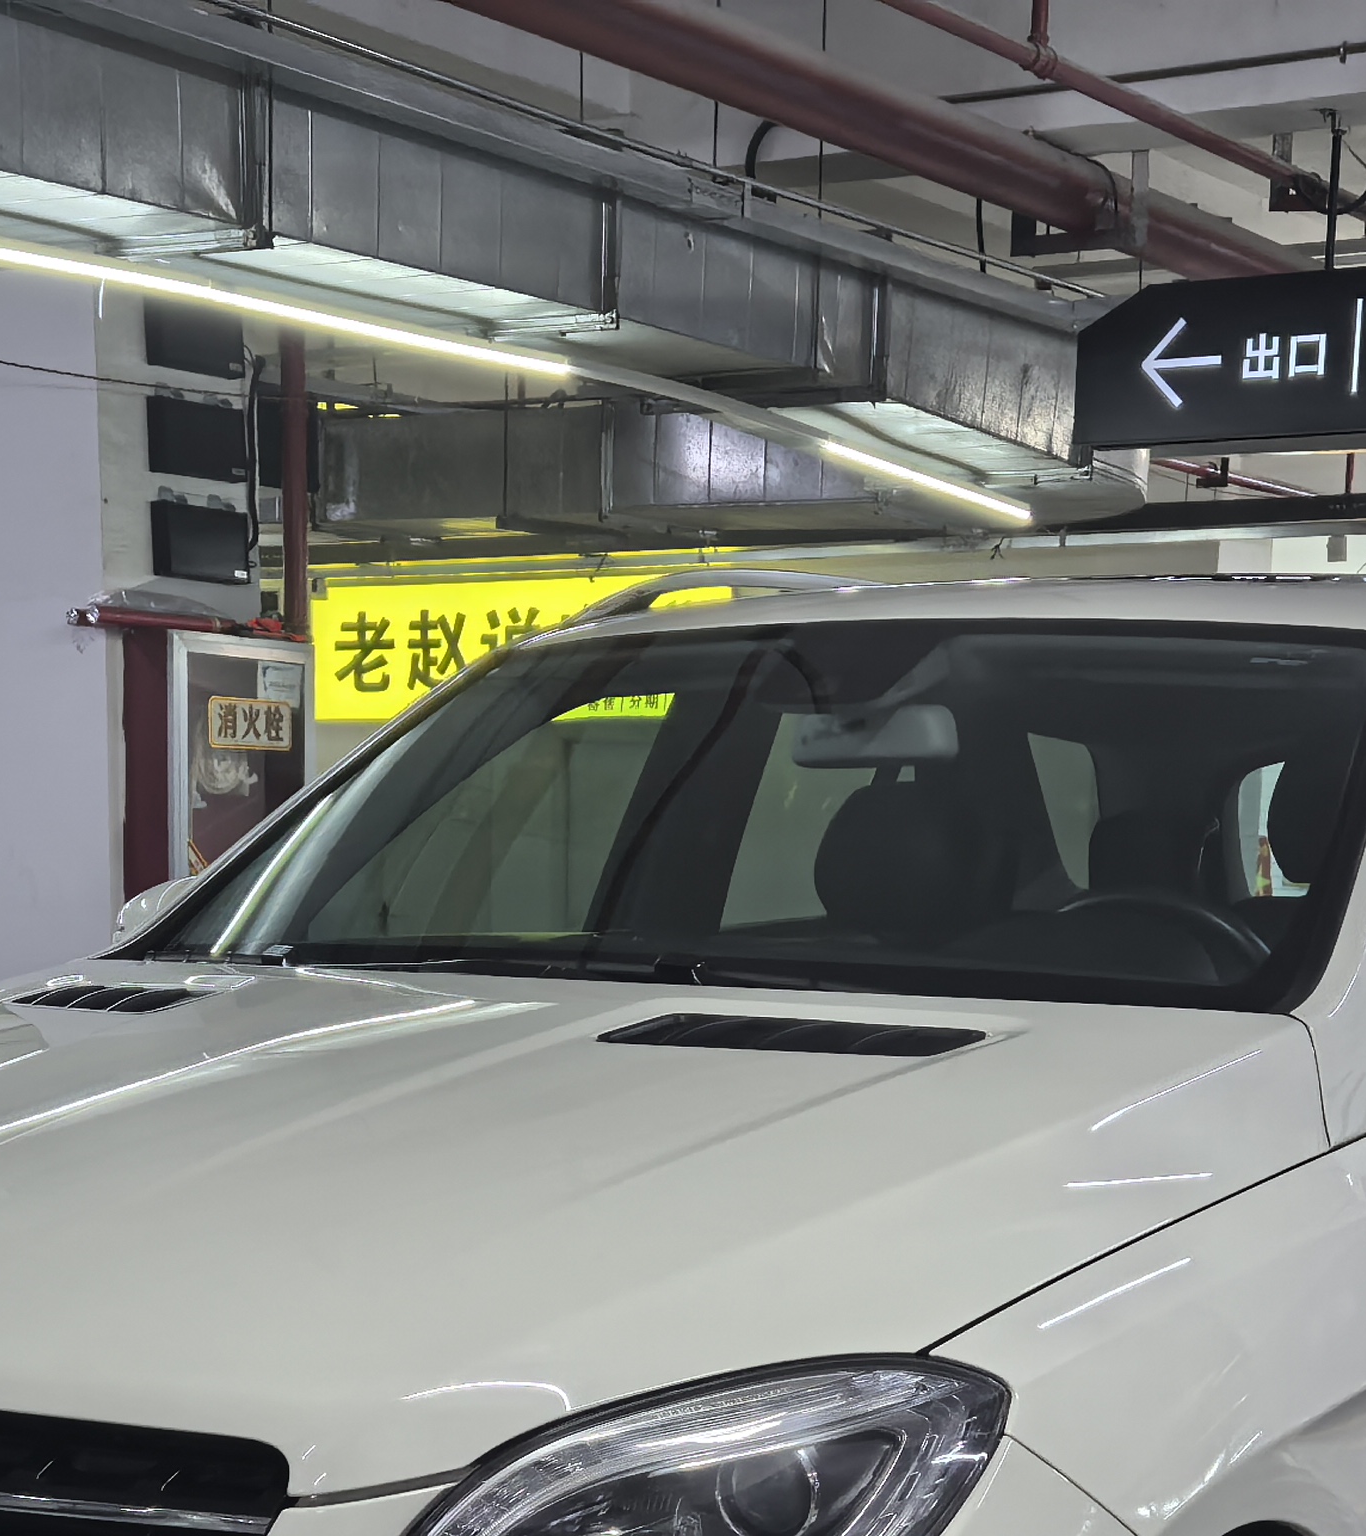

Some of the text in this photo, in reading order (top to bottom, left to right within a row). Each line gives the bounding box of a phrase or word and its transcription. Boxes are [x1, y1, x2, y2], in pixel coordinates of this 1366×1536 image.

[1242, 332, 1327, 380] 出口
[217, 702, 284, 741] 消火栓
